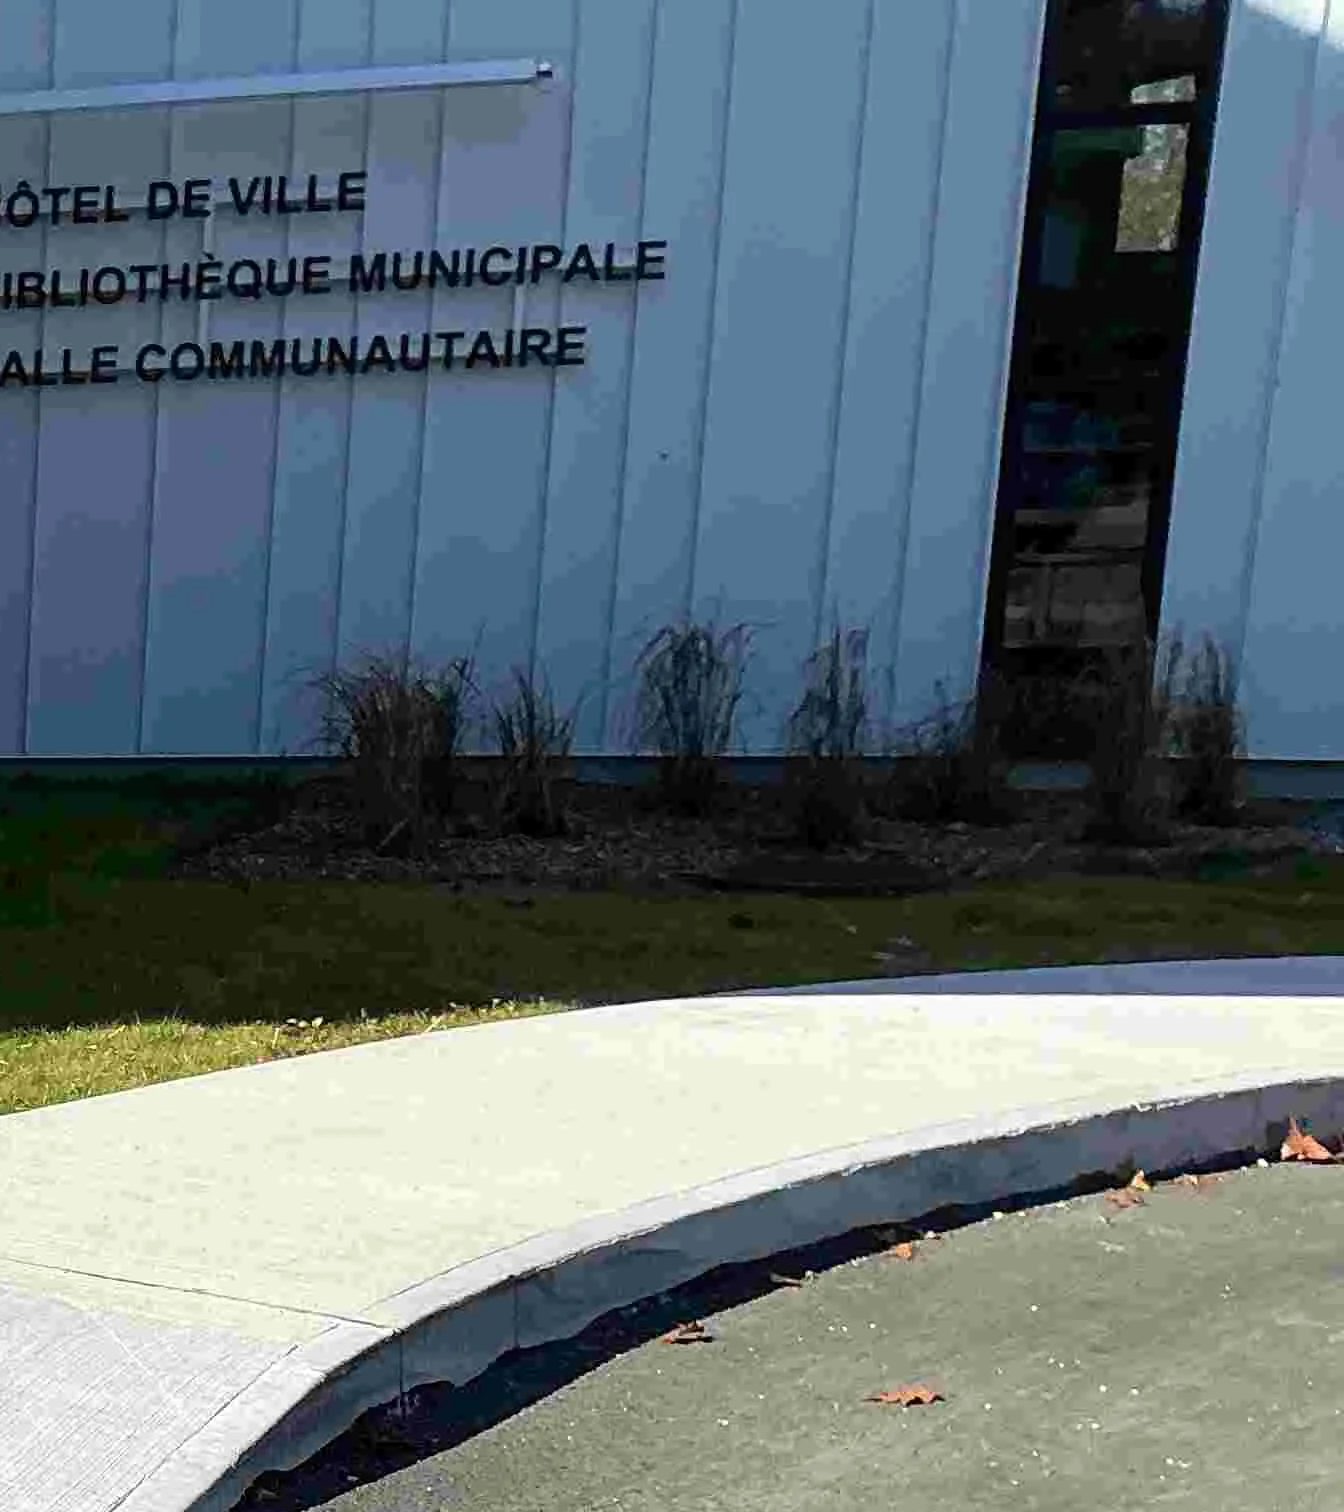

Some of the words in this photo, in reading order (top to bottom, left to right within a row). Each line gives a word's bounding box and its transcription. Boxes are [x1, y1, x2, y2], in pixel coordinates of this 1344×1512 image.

[147, 180, 211, 219] DE
[228, 172, 367, 215] VILLE
[349, 240, 667, 293] MUNICIPALE
[135, 327, 586, 382] COMMUNAUTAIRE
